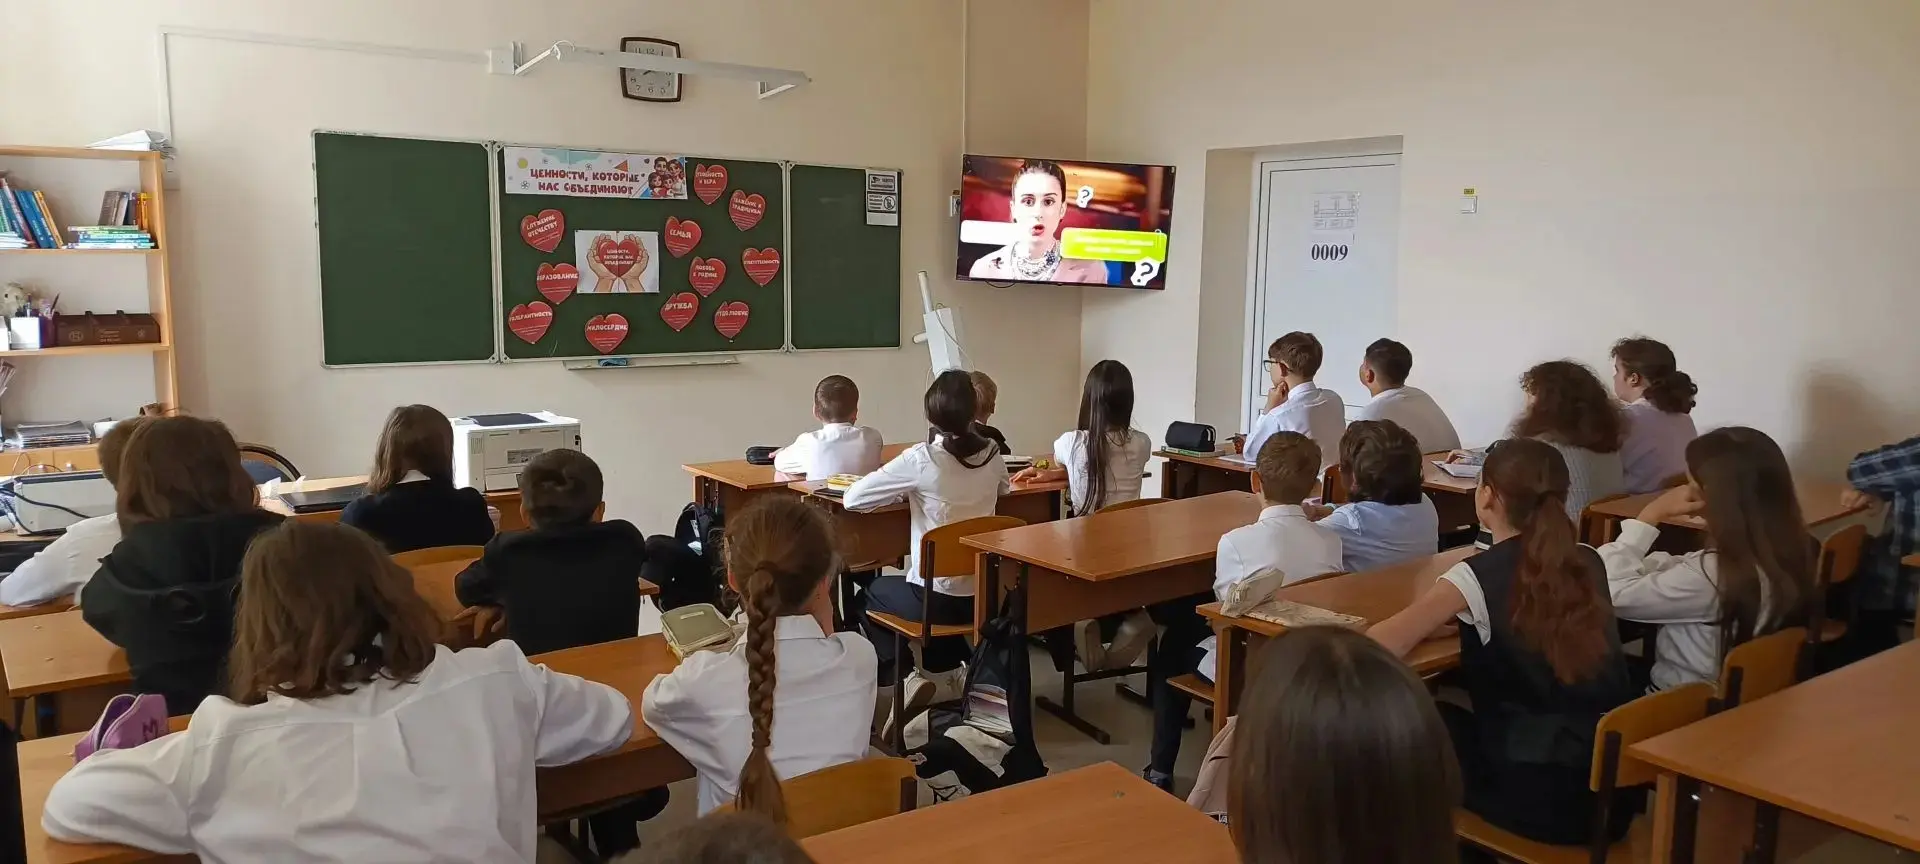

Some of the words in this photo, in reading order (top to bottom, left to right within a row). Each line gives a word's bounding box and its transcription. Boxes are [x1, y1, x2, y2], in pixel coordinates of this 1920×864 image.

[530, 168, 588, 182] ЦЕННОСТИ,
[538, 181, 560, 192] НАС
[564, 183, 633, 195] ОБЪЕДИНЯЮТ
[669, 229, 692, 239] СЕМЬЯ
[1311, 243, 1349, 261] 0009
[664, 302, 693, 311] ДРУЖБА
